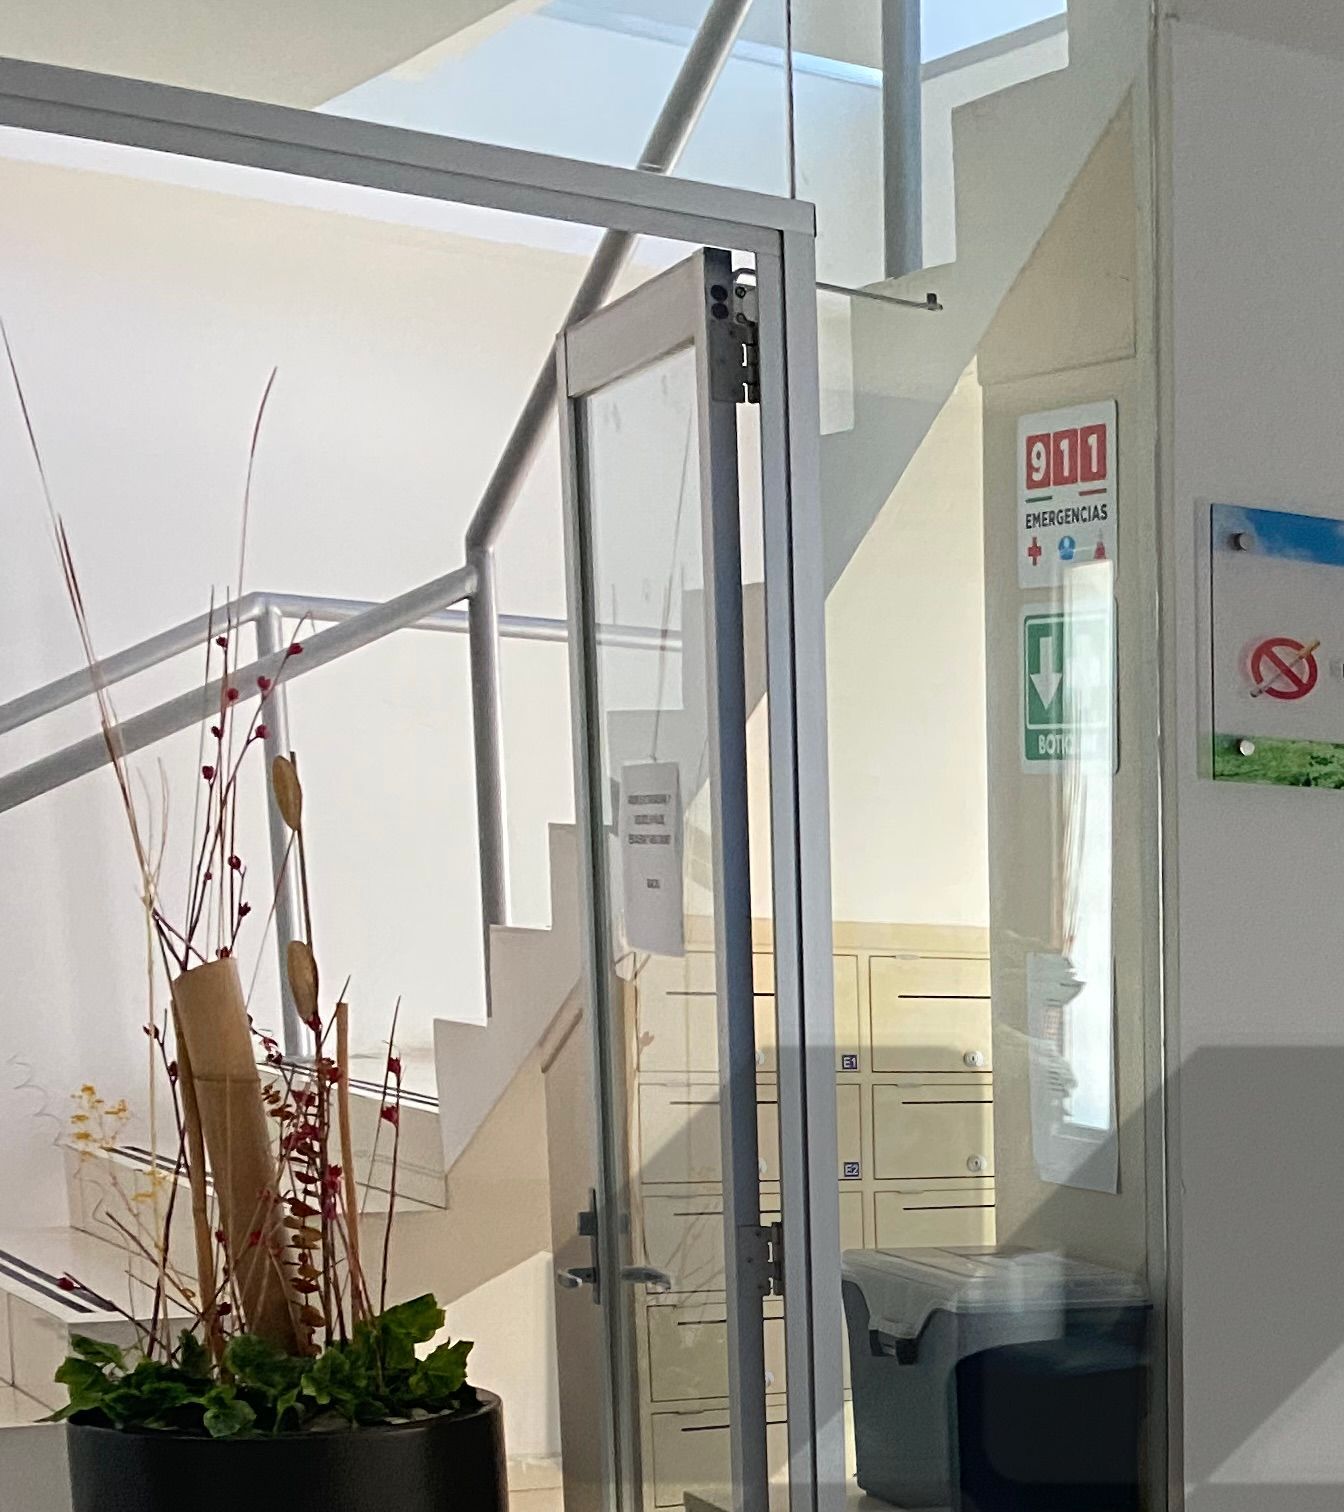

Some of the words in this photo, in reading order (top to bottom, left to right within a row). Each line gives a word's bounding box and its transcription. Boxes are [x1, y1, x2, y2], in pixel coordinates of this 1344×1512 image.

[1030, 433, 1098, 482] 911
[1025, 503, 1108, 530] EMERGENCIAS
[843, 1056, 857, 1069] E1
[845, 1163, 859, 1176] E2
